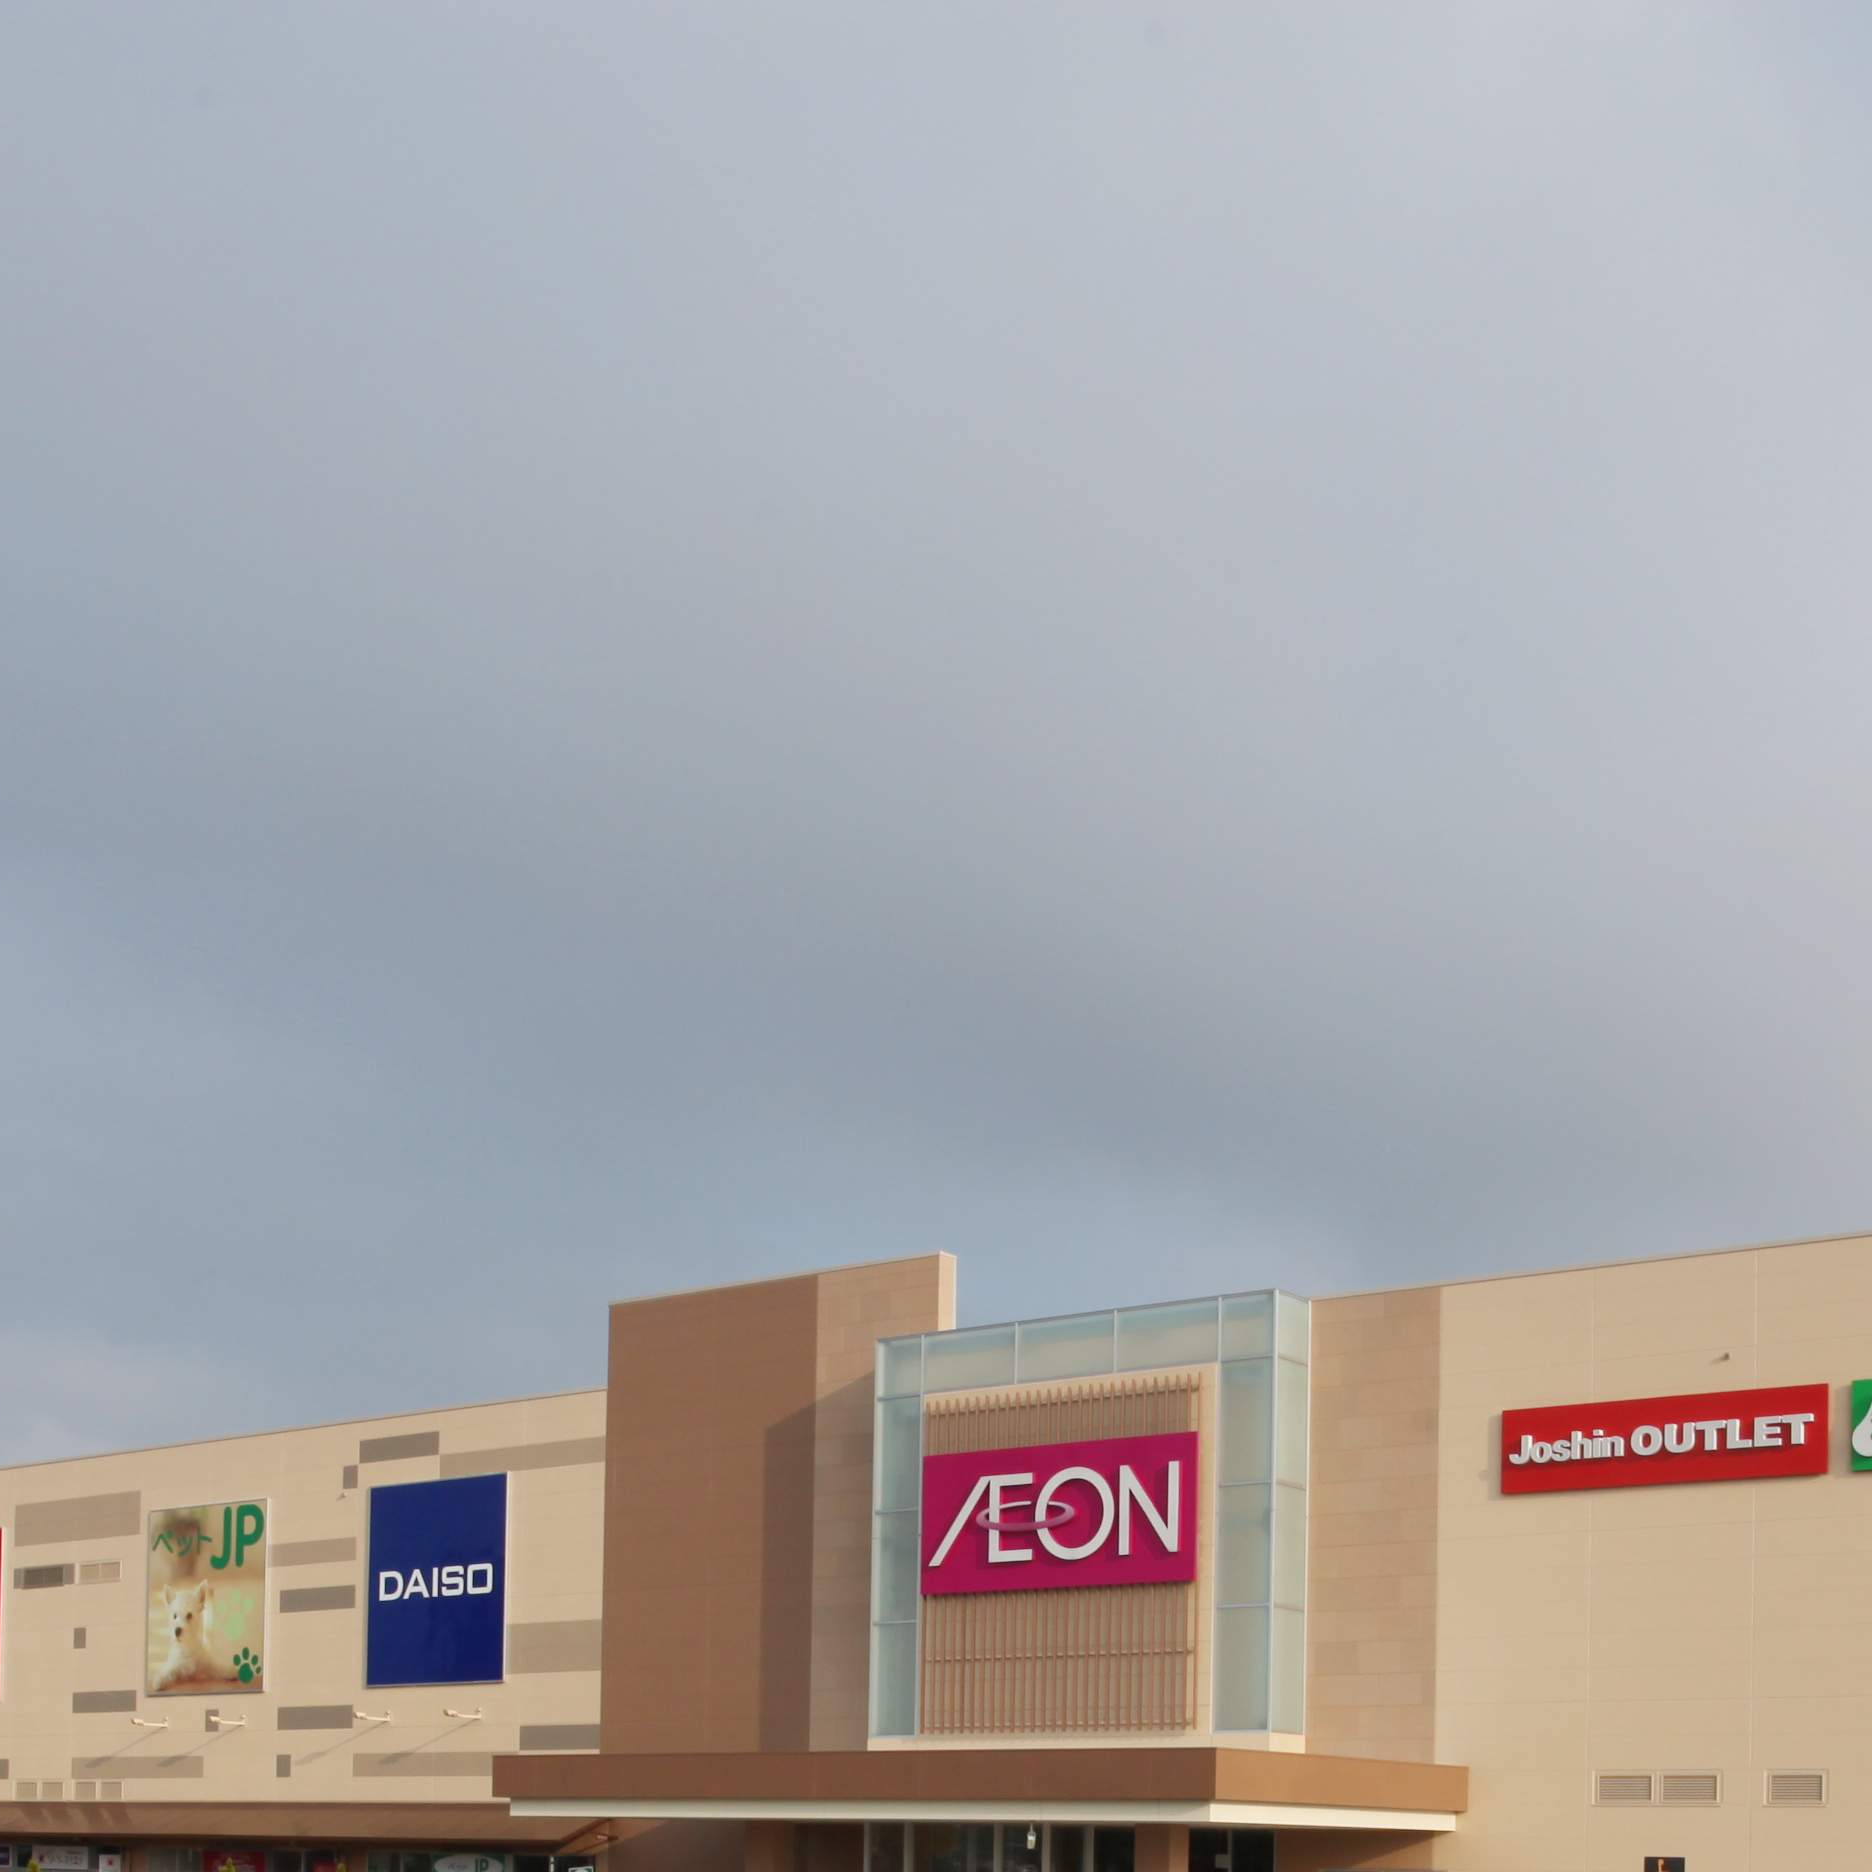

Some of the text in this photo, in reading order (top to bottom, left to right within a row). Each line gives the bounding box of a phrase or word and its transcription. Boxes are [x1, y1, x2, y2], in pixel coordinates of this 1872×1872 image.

[1509, 1413, 1815, 1465] Joshin OUTLET
[151, 1504, 265, 1570] ペット JP
[378, 1562, 494, 1602] DAISO
